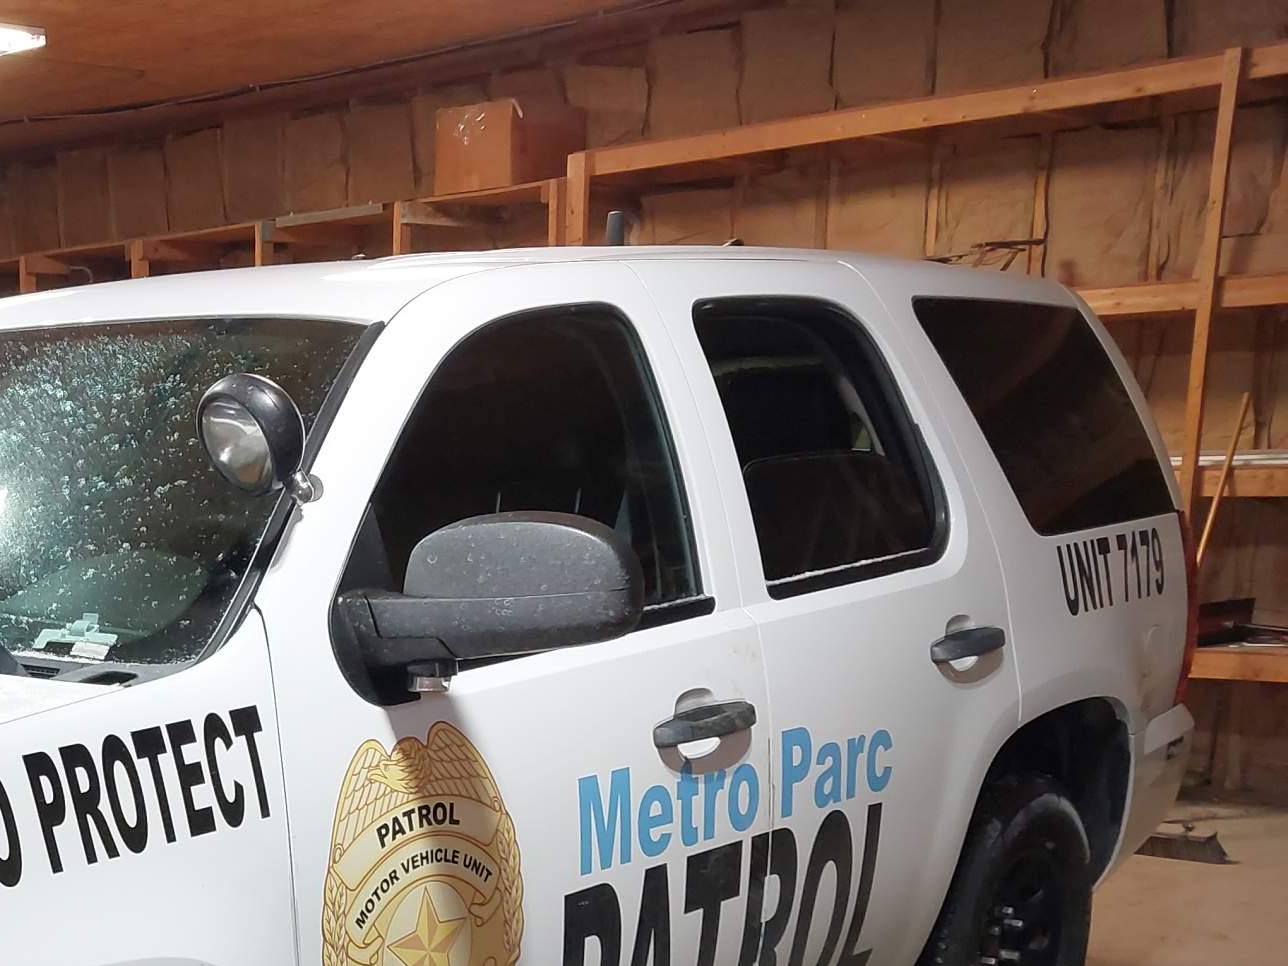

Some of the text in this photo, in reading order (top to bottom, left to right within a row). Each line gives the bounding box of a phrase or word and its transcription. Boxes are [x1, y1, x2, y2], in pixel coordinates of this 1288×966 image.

[1056, 528, 1164, 617] UNIT 7179
[22, 705, 270, 874] PROTECT
[376, 801, 460, 848] PATROL
[577, 727, 894, 876] Metro Parc
[355, 848, 493, 929] MOTOR VEHICLE UNIT
